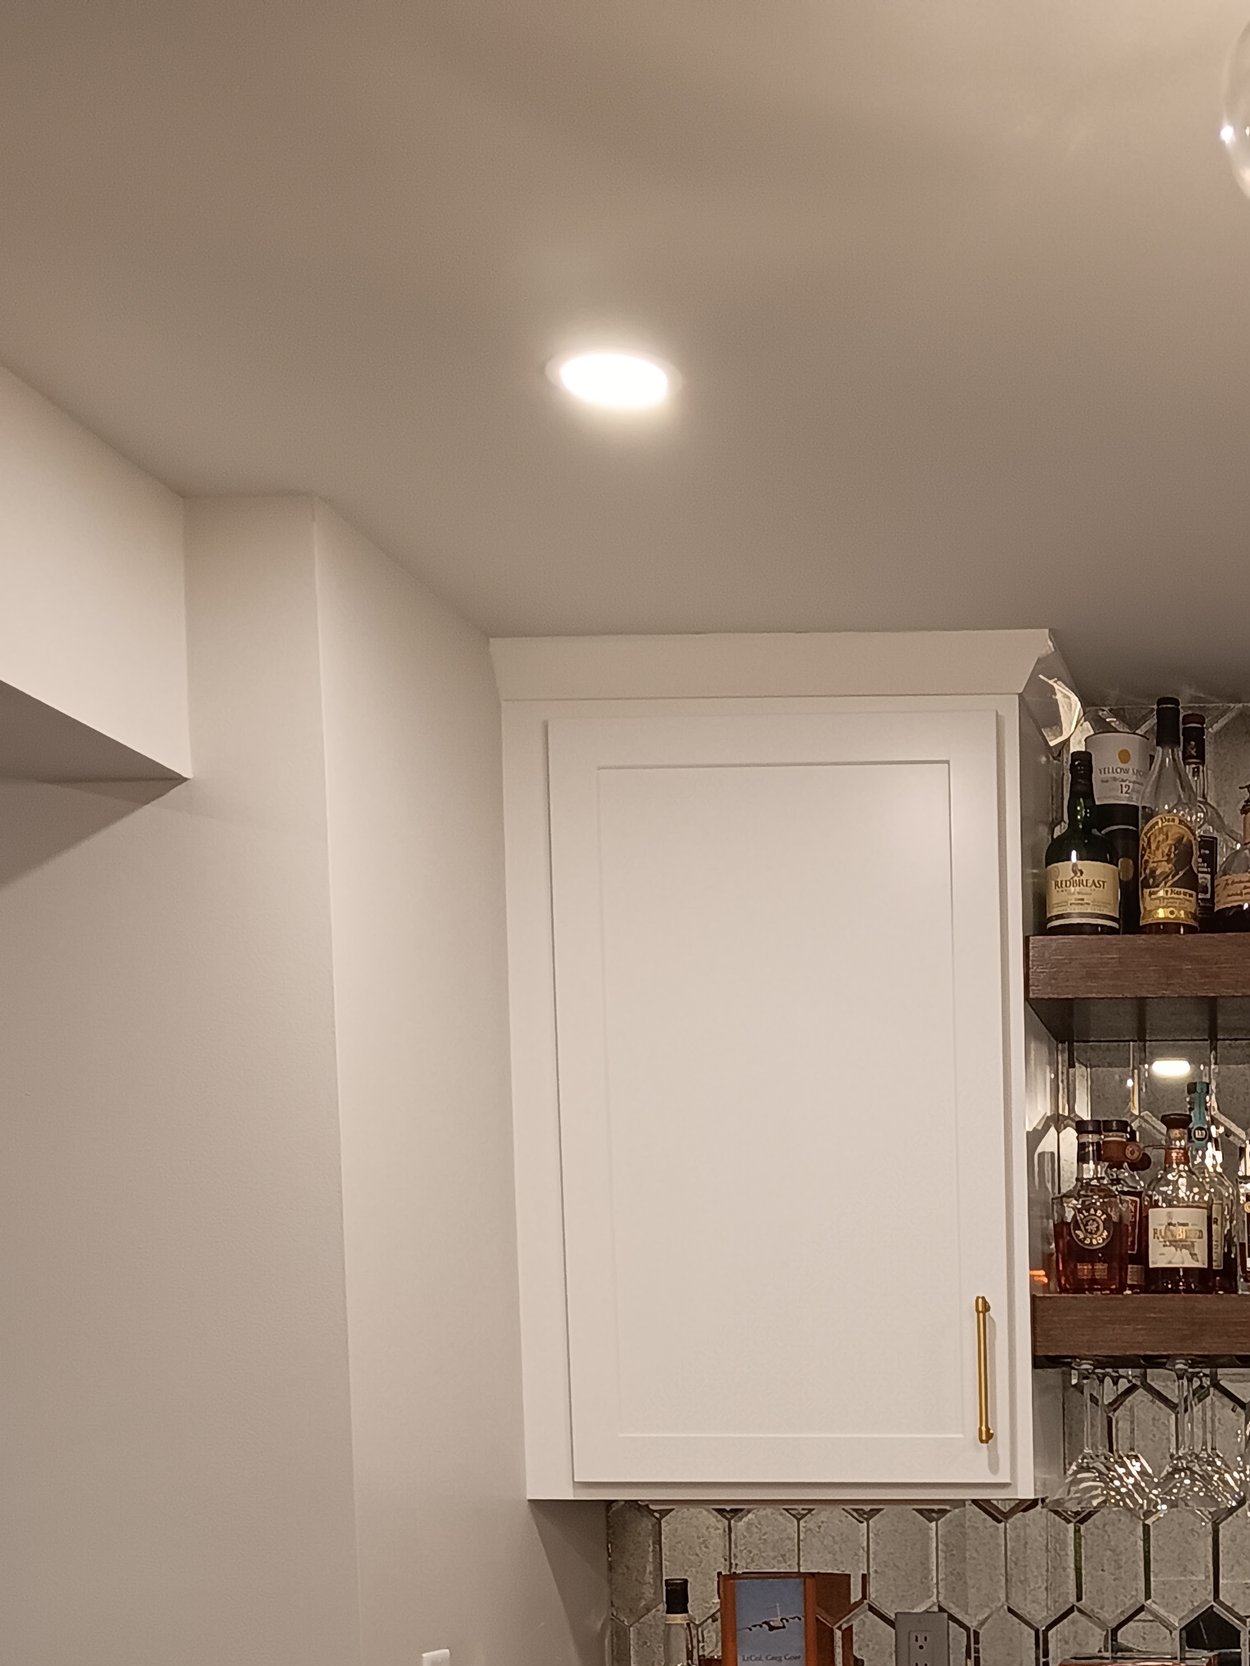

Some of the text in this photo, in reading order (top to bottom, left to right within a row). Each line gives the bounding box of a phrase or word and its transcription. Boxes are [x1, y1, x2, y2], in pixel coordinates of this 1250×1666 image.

[1098, 766, 1150, 777] YELLOW SPO
[1119, 783, 1131, 795] 12
[1053, 878, 1108, 891] REDBREAST
